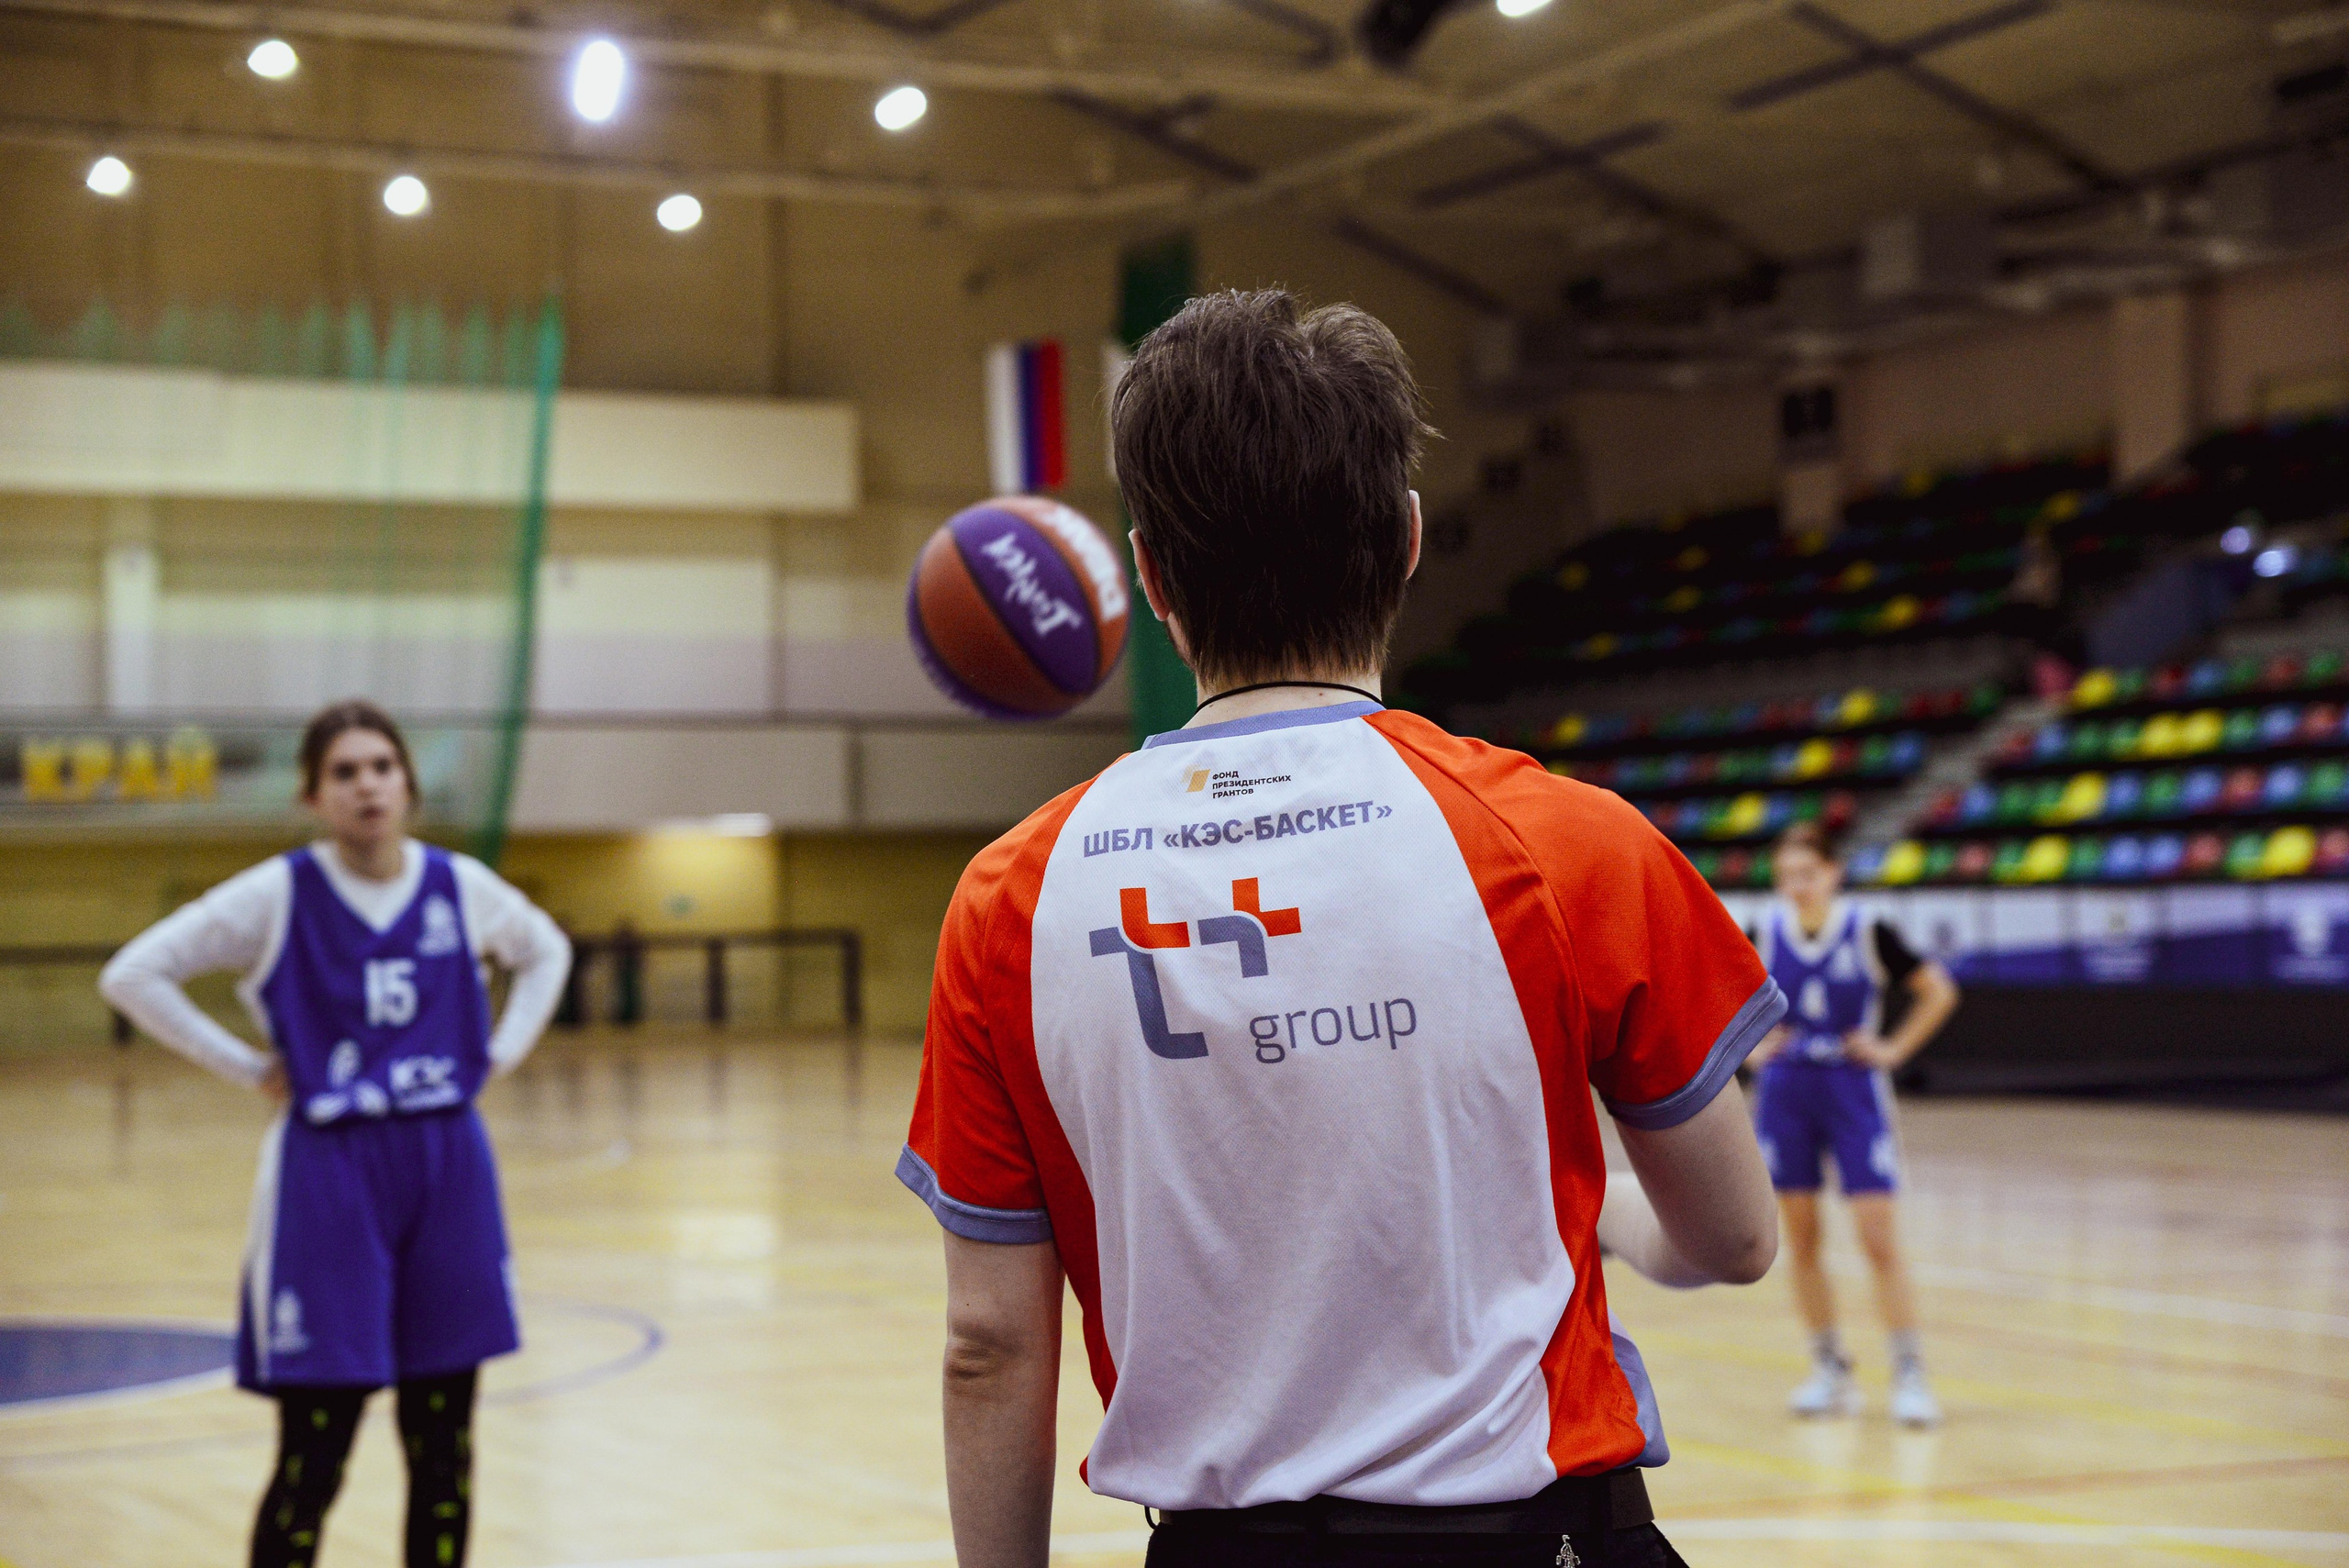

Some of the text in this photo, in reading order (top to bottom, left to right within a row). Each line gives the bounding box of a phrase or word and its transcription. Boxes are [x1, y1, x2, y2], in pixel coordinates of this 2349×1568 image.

[1212, 771, 1240, 780] ФОНД
[1212, 774, 1292, 790] ПРЕЗИДЕНТСКИХ
[1212, 788, 1254, 799] ГРАНТОВ
[1083, 800, 1393, 858] ШБЛ «КЭС-БАСКЕТ»
[363, 957, 418, 1029] 15
[1249, 996, 1418, 1064] group
